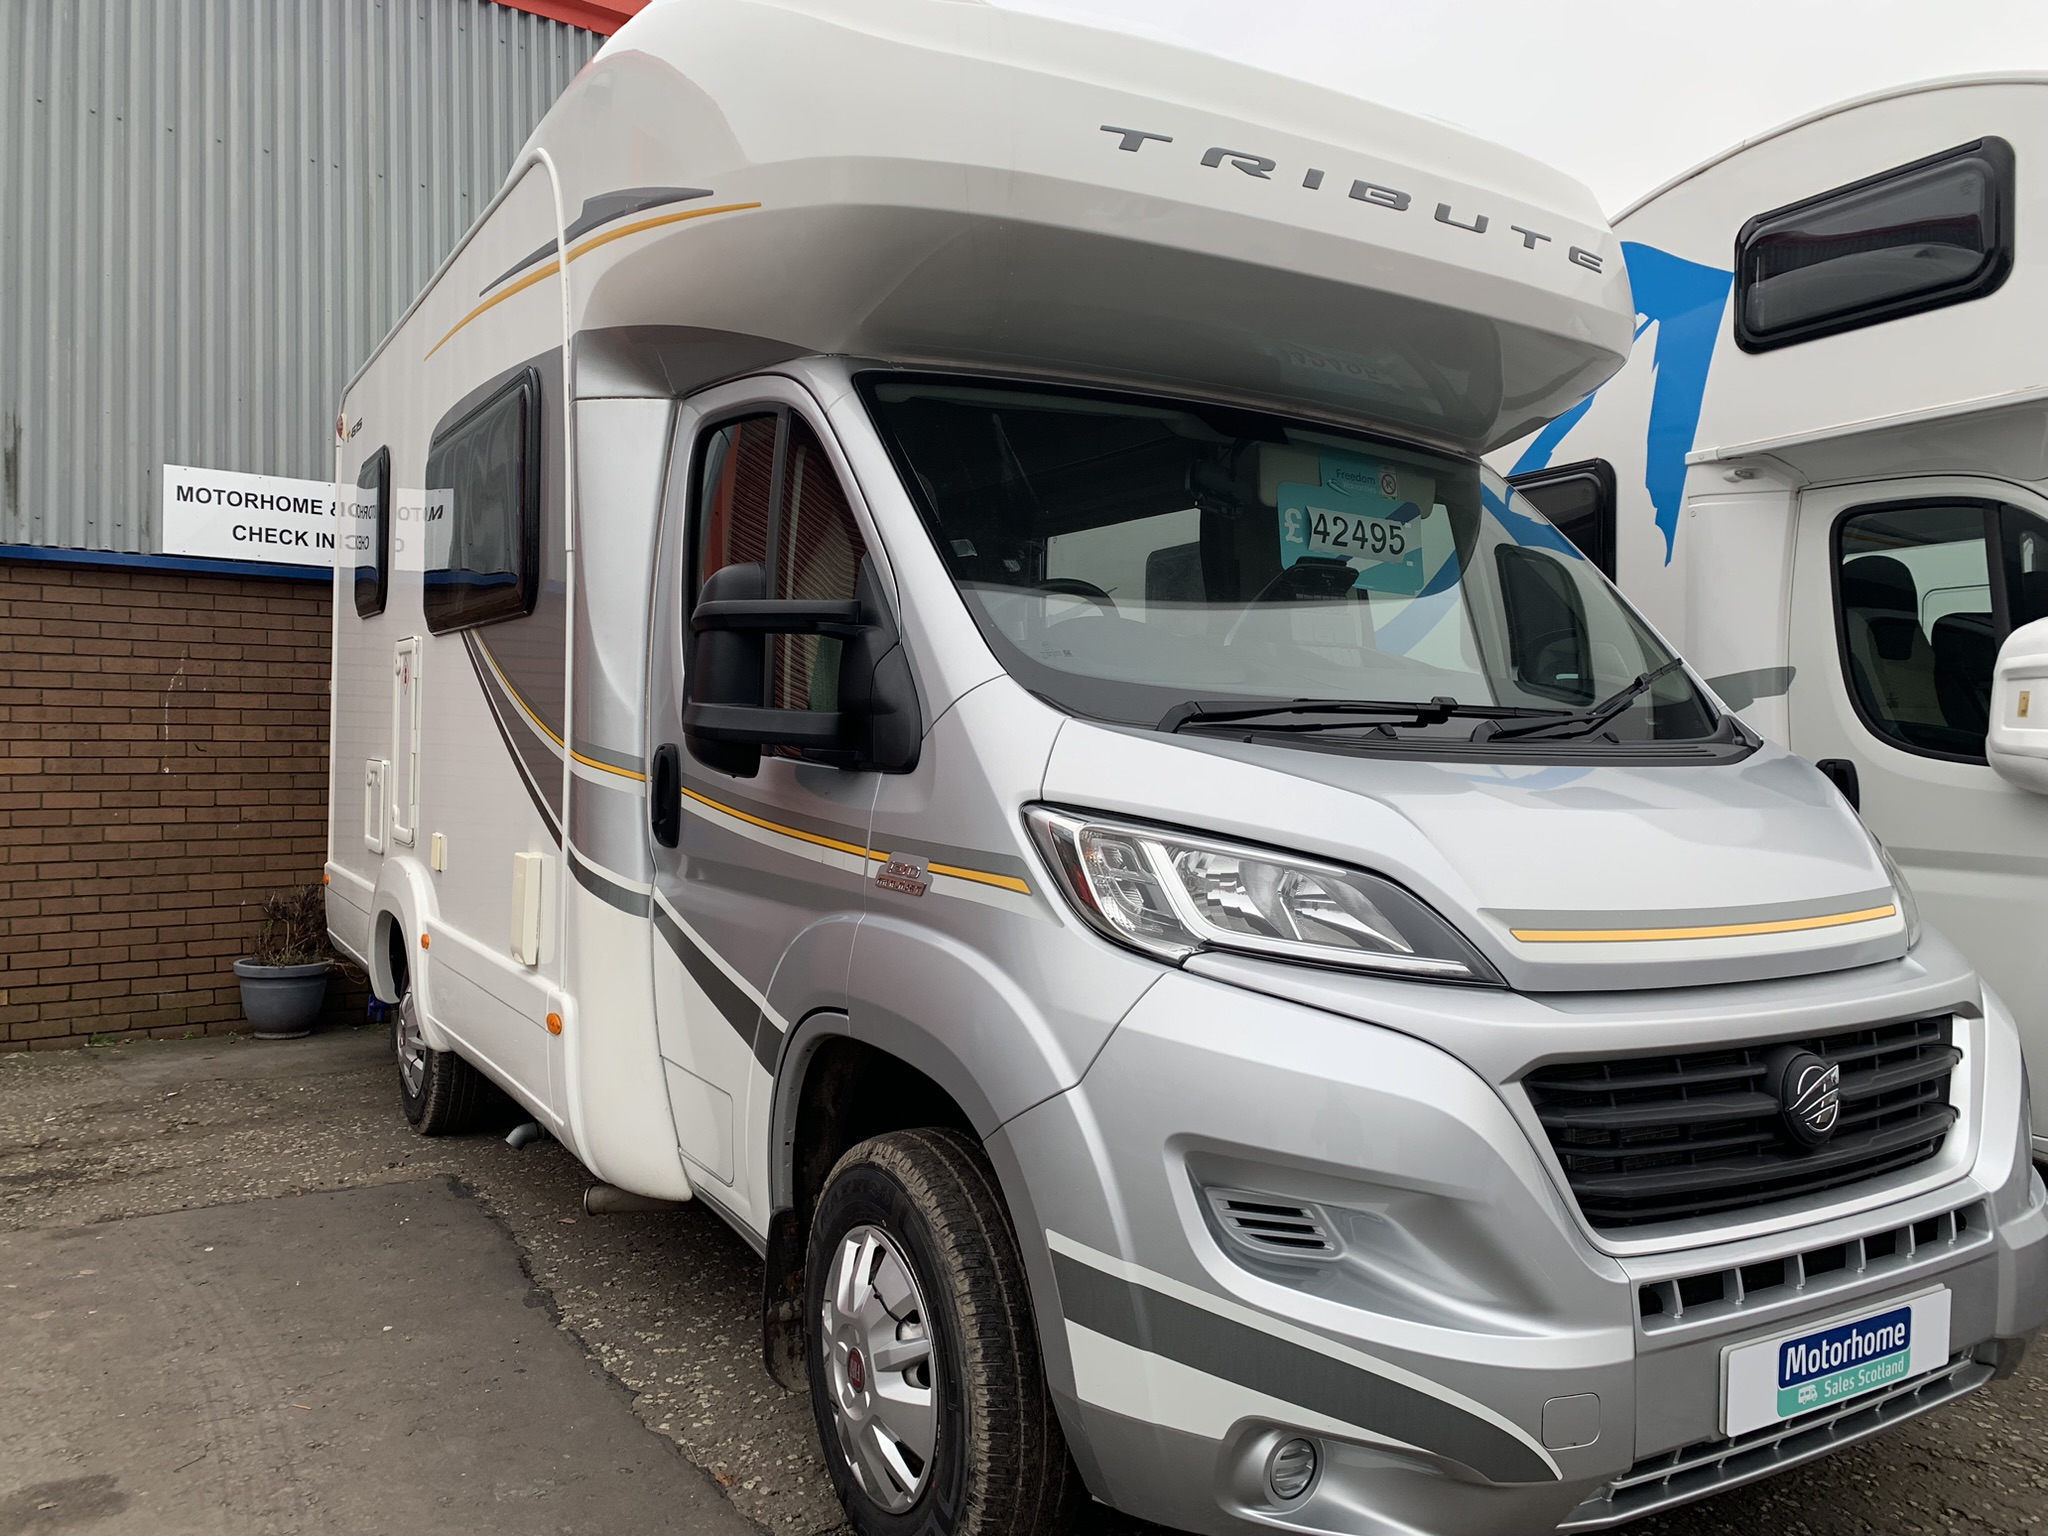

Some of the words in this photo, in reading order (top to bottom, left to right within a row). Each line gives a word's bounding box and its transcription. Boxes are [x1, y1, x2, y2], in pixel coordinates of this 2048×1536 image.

[1099, 124, 1603, 274] TRIBUTE
[1336, 468, 1376, 485] Freedom
[176, 484, 323, 516] MOTORHOME
[232, 524, 309, 547] CHECK
[315, 532, 335, 550] IN
[1313, 513, 1405, 555] 42495
[1785, 1322, 1905, 1381] Motorhome
[1824, 1376, 1855, 1398] Sales
[1858, 1358, 1904, 1386] Scotland
